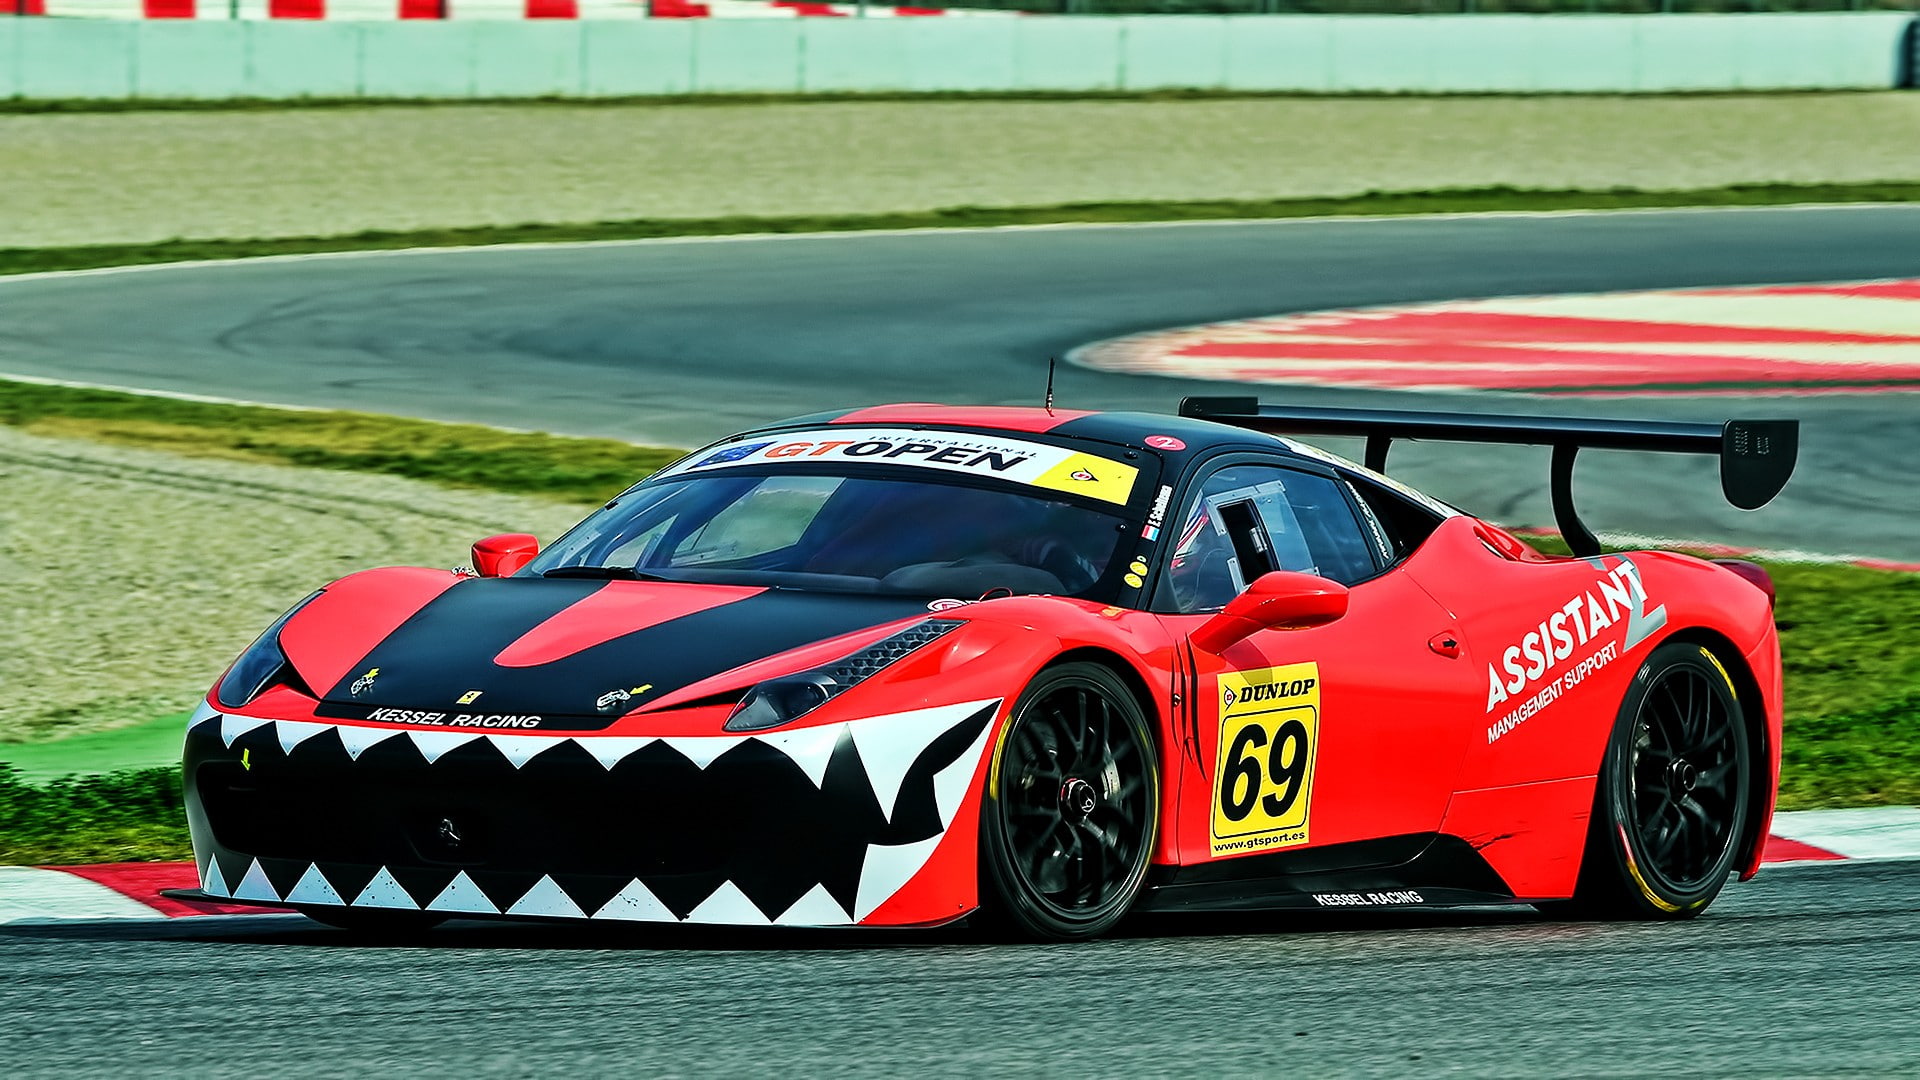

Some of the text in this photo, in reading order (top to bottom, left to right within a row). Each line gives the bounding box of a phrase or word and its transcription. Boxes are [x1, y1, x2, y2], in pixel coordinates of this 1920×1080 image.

[869, 436, 1038, 458] INTERNATIONAL
[1486, 560, 1648, 714] ASSISTANT
[1239, 678, 1315, 703] DUNLOP
[1487, 640, 1619, 745] MANAGEMENT SUPPORT
[366, 707, 542, 728] KESSEL RACING
[1220, 719, 1309, 822] 69
[1214, 831, 1305, 852] www.gtsport.es
[1312, 890, 1424, 906] KESSEL RACING
